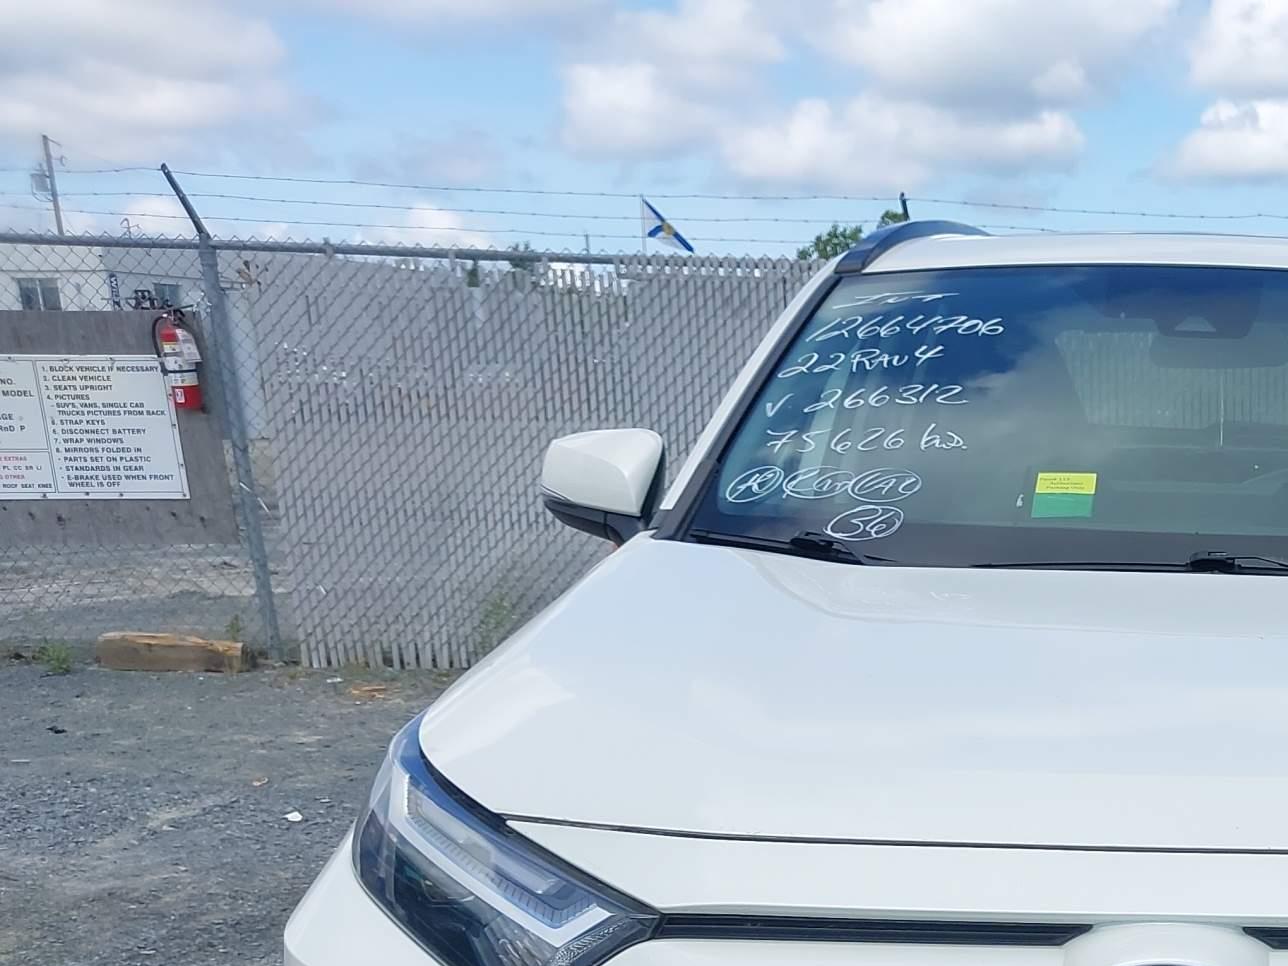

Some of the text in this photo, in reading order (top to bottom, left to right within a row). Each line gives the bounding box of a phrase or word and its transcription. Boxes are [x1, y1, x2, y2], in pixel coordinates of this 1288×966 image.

[805, 315, 1004, 342] 12664706
[803, 383, 970, 413] 266312
[766, 427, 905, 454] 75626
